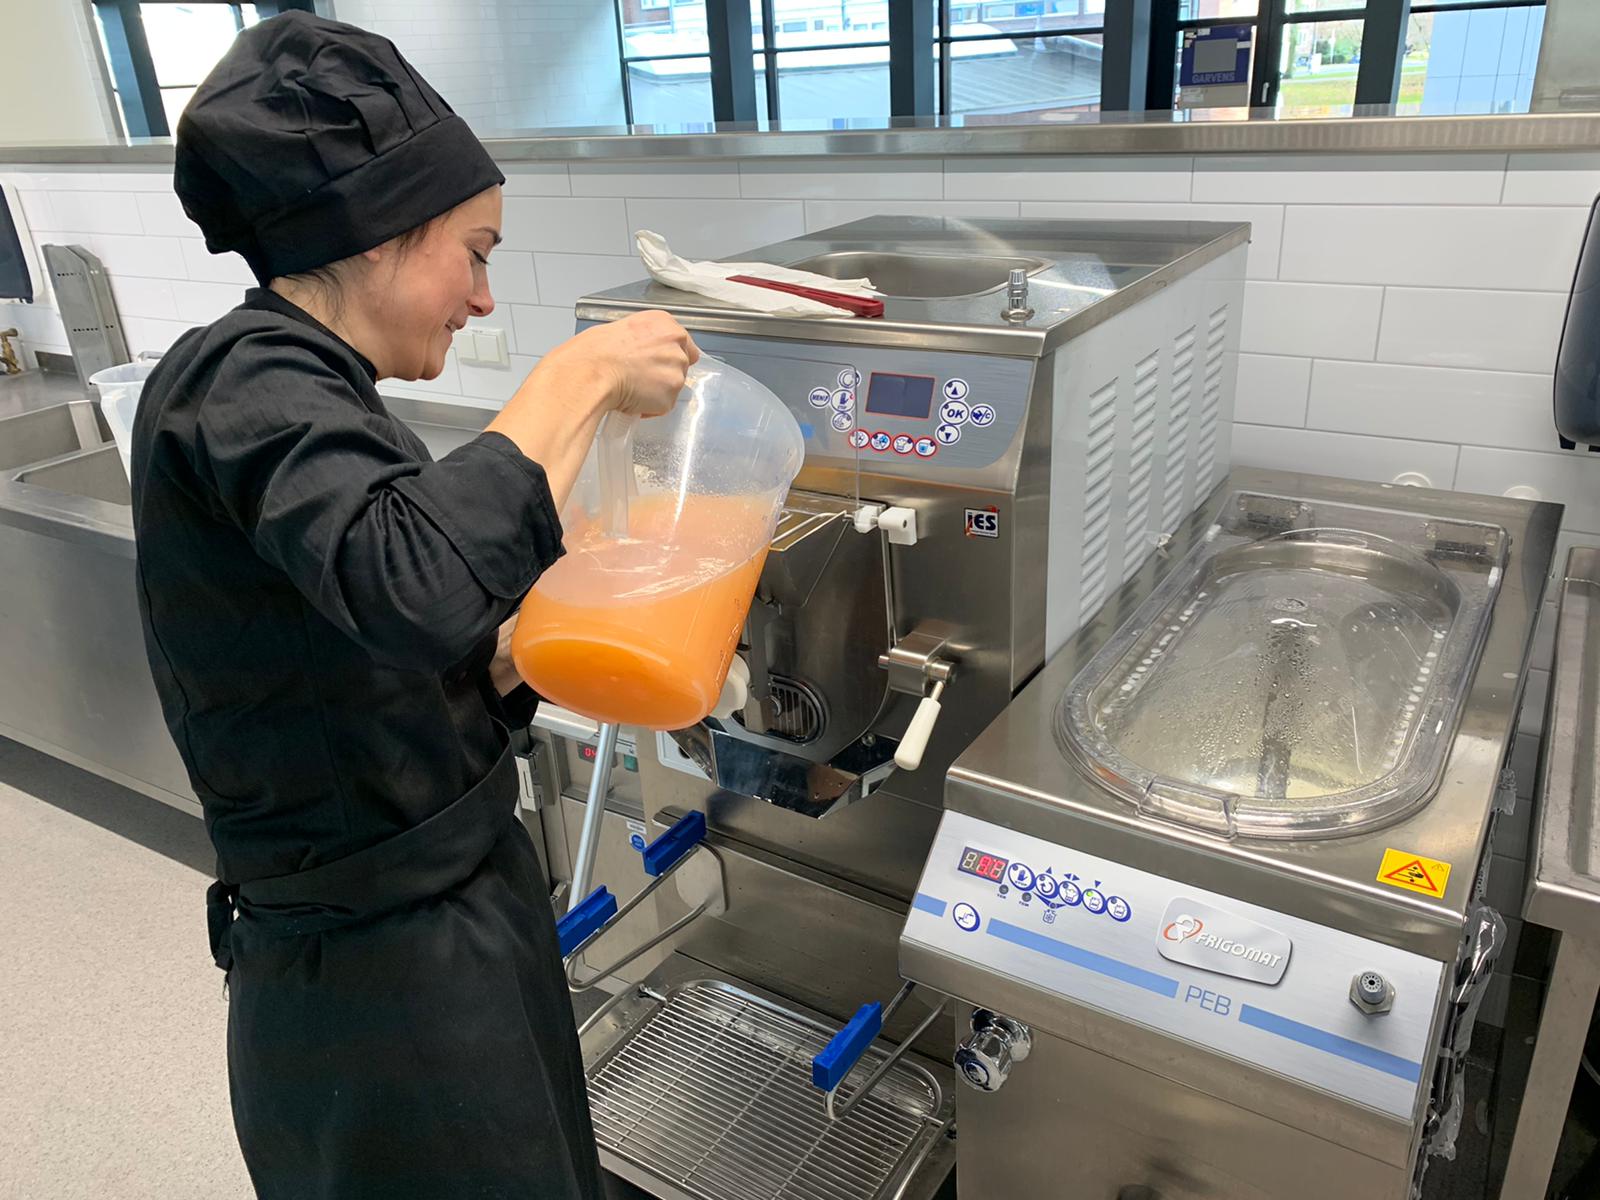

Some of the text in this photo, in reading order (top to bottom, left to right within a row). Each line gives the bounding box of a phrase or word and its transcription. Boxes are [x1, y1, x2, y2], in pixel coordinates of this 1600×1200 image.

[1192, 72, 1235, 84] GARVENS
[947, 409, 965, 419] OK
[1195, 931, 1282, 968] FRIGOMAT
[1185, 984, 1232, 1016] PEB
